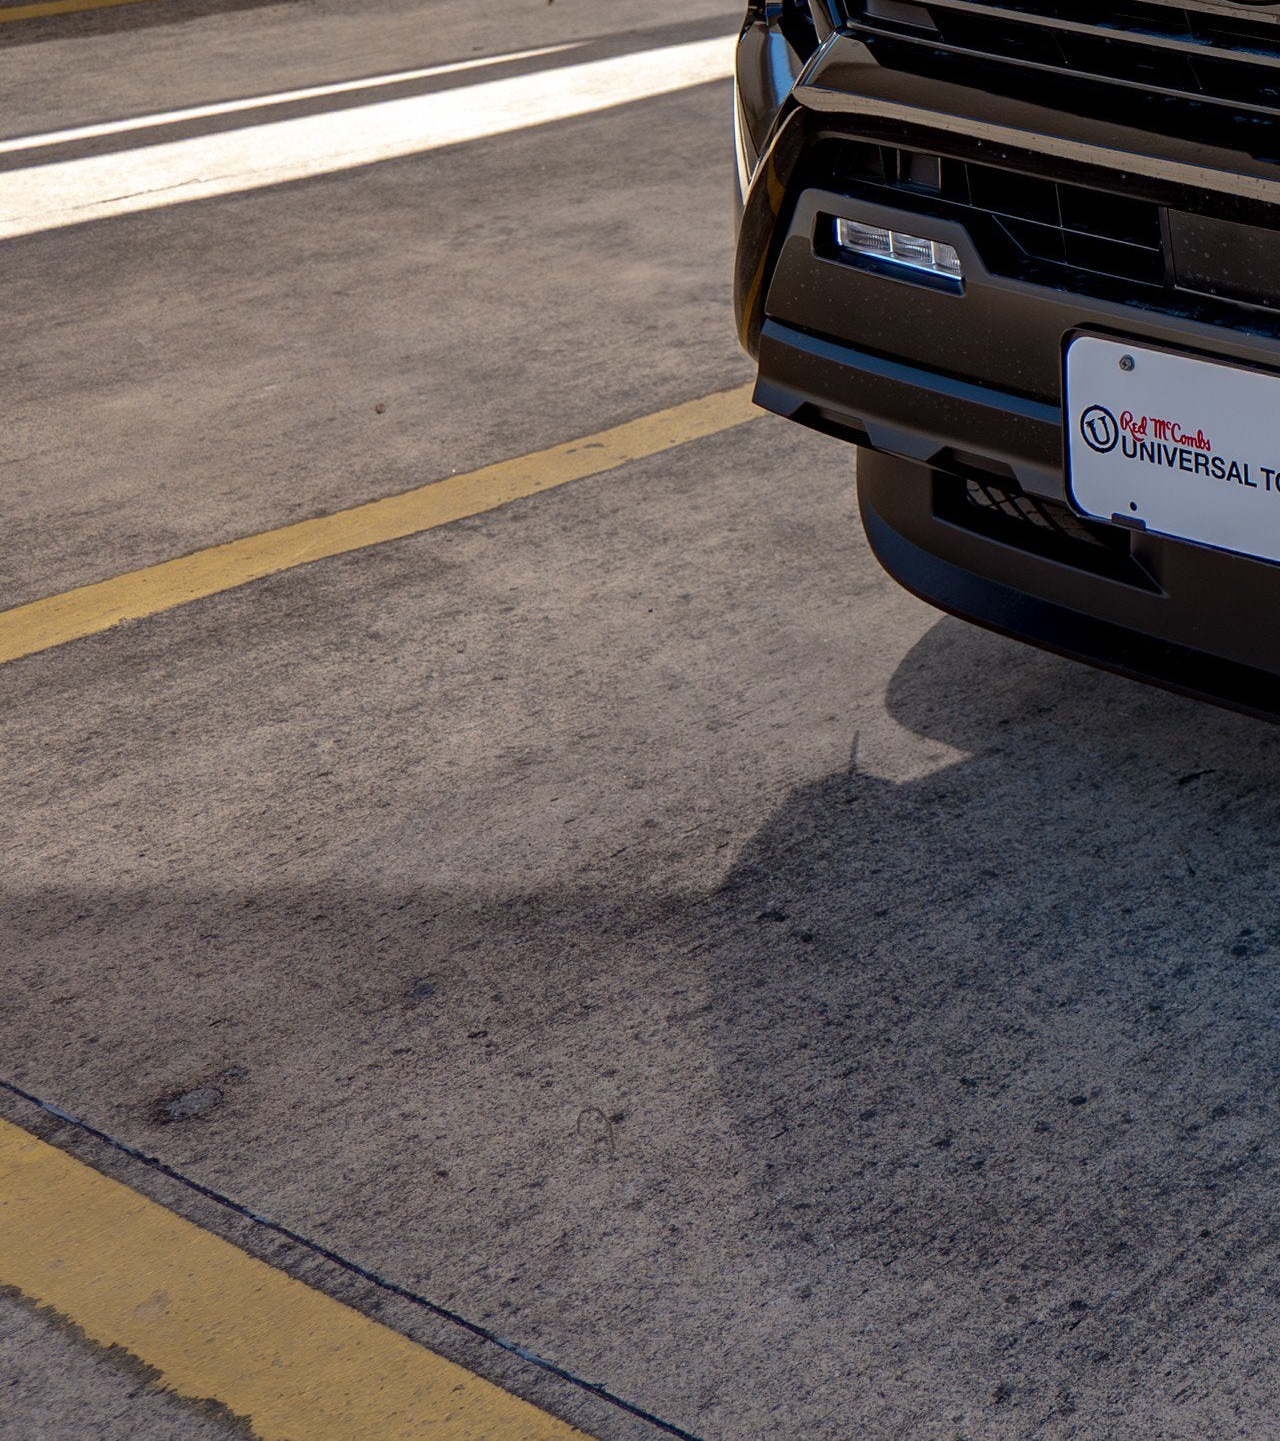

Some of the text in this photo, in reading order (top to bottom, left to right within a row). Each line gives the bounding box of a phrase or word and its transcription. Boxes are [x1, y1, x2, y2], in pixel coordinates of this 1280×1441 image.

[1120, 410, 1211, 451] Red McCombs
[1121, 435, 1258, 487] UNIVERSAL
